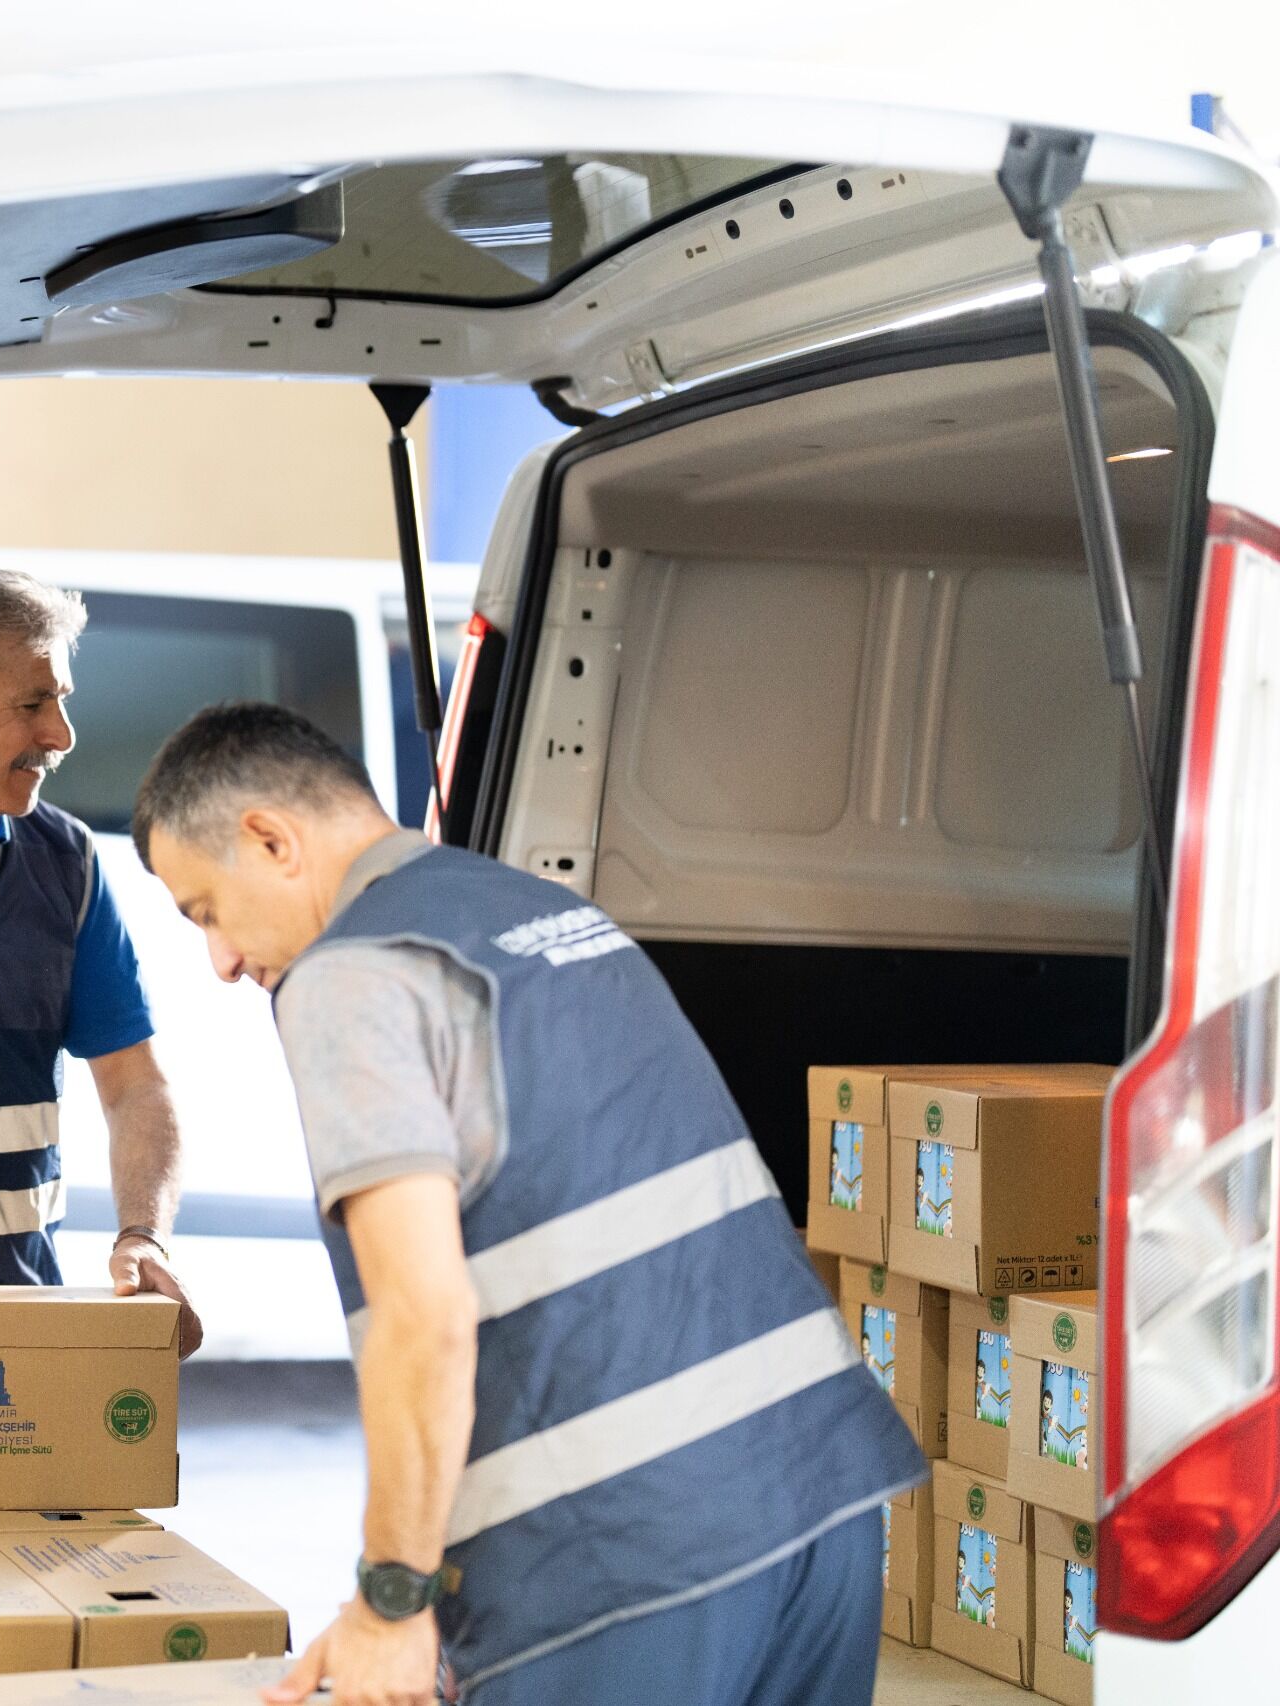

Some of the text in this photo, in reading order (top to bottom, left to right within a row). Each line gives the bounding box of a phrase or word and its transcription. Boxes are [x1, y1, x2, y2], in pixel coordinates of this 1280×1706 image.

[996, 1256, 1010, 1264] Net
[1037, 1255, 1045, 1263] 12
[1045, 1255, 1063, 1263] adet
[32, 1444, 53, 1454] Sütü
